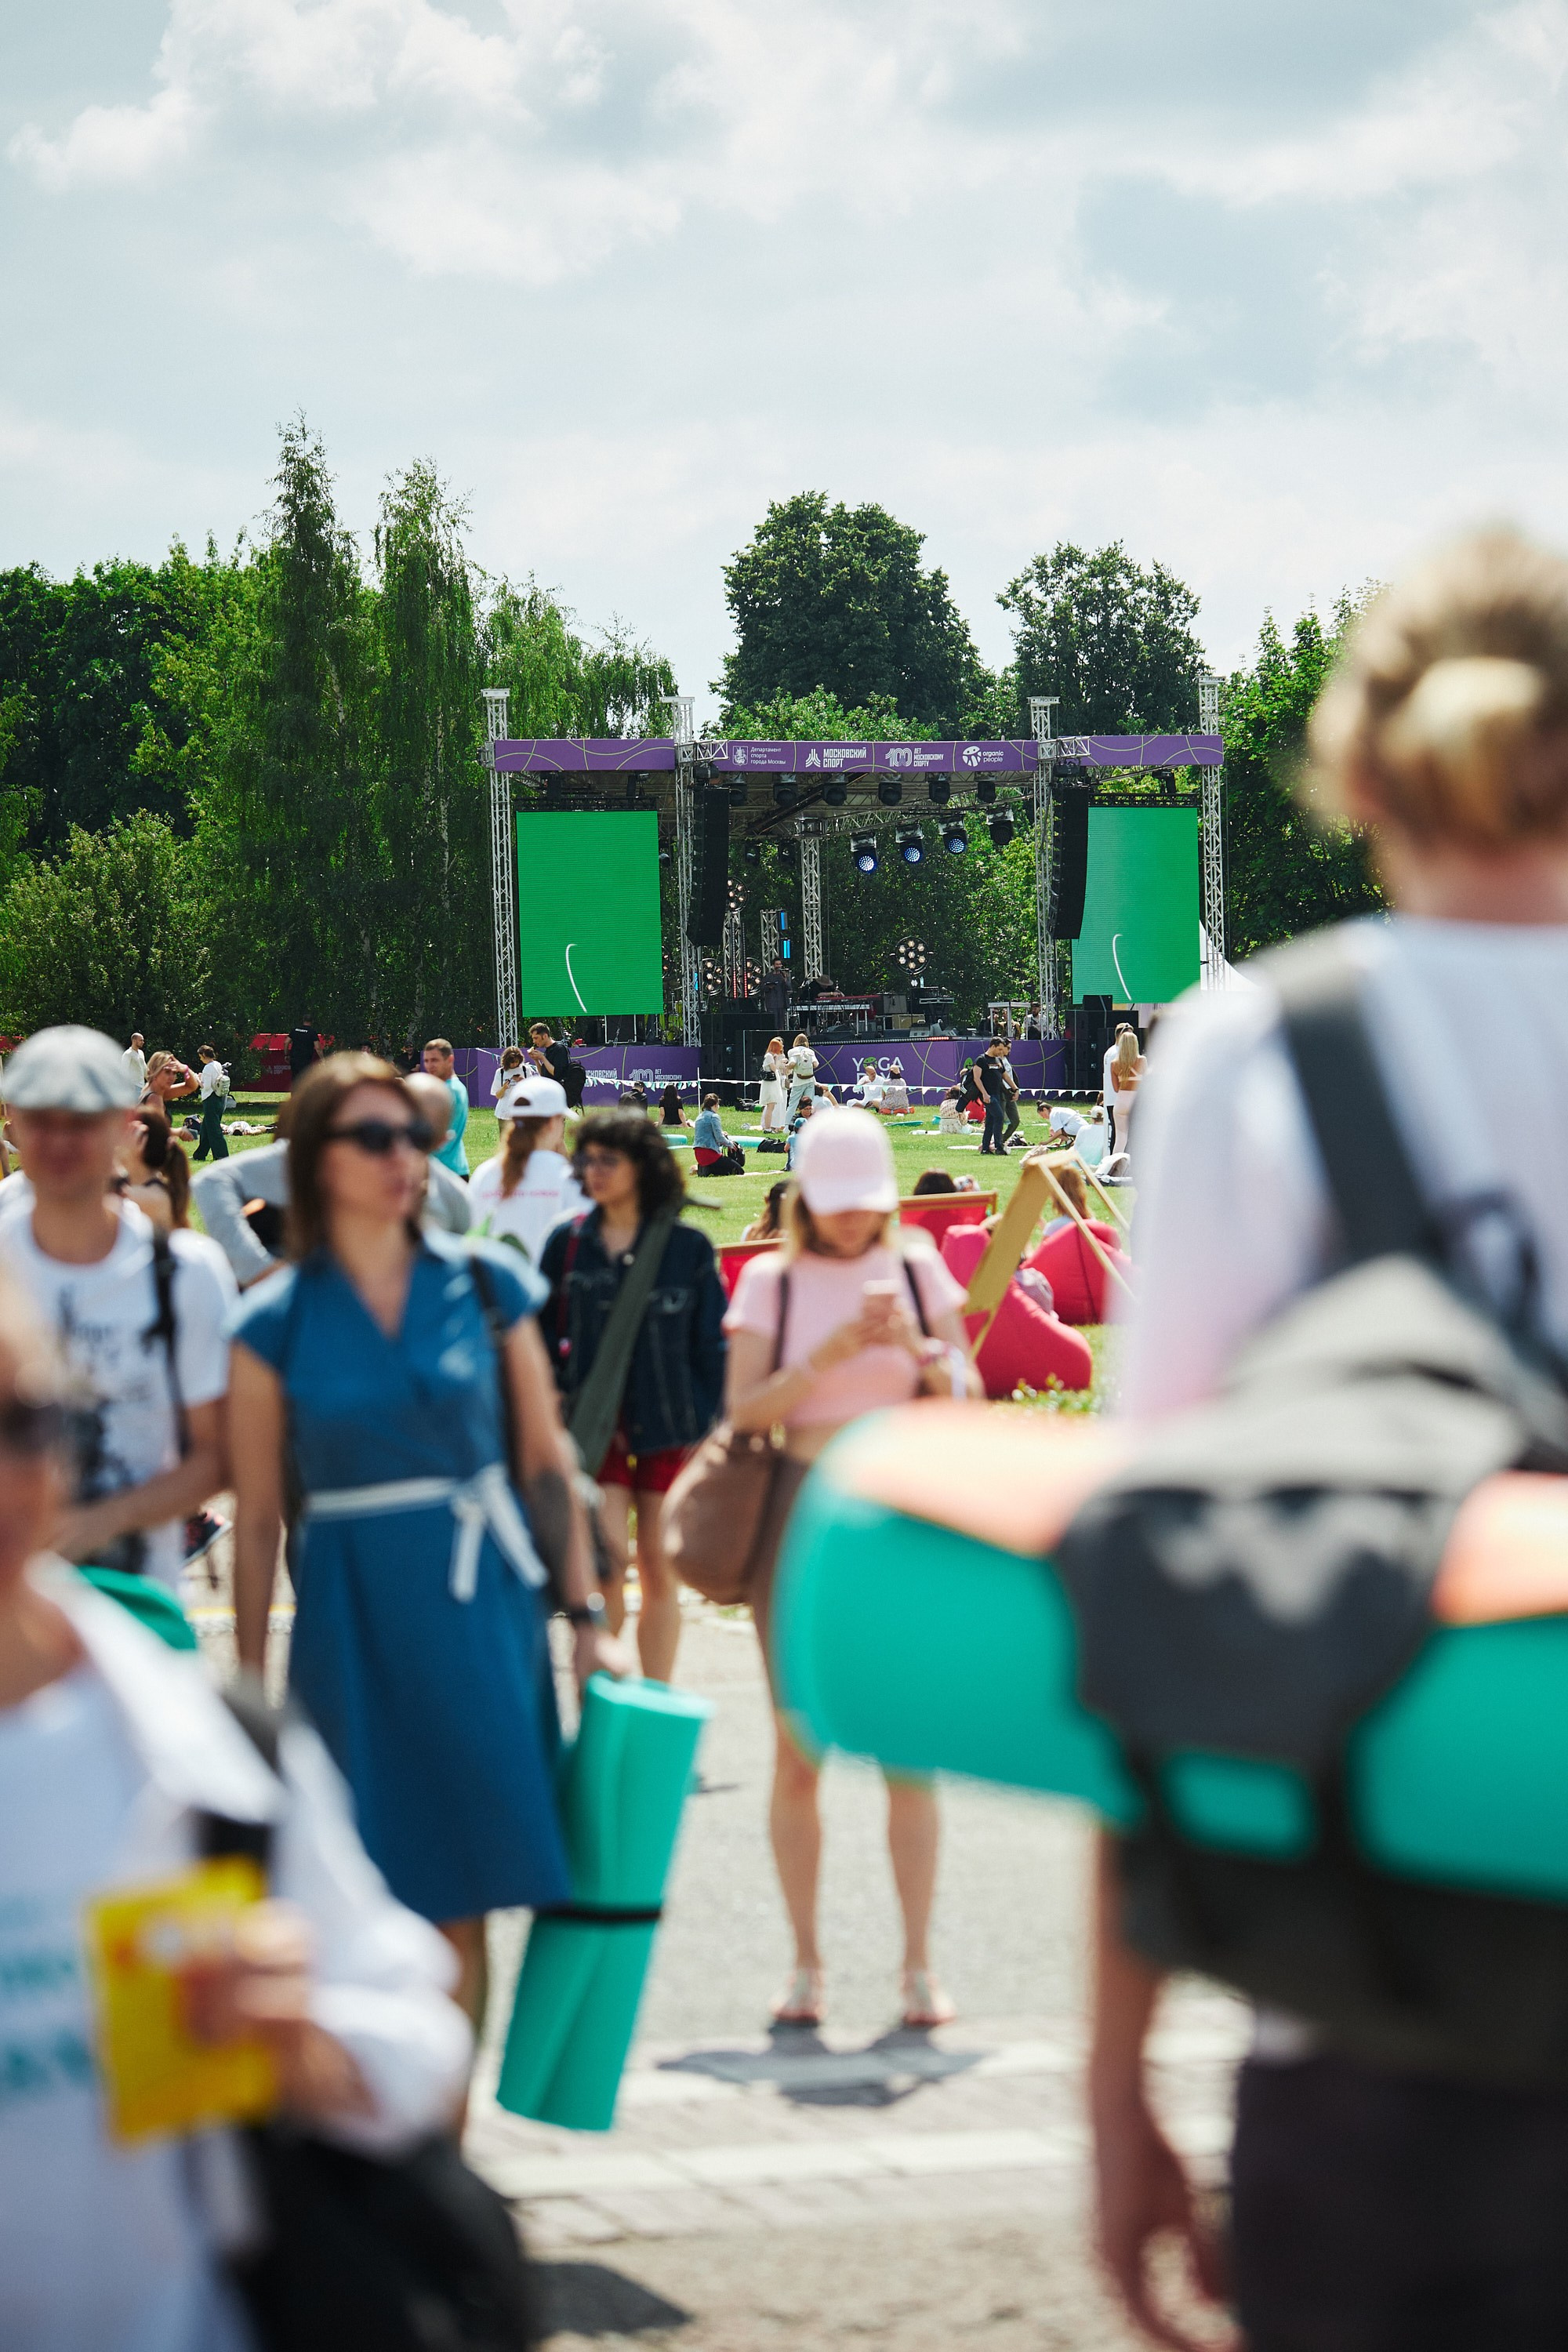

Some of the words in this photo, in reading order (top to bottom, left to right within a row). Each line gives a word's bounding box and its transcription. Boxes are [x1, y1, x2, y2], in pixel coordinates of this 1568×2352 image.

[823, 747, 866, 758] МОСКОВСКИЙ
[885, 748, 913, 767] 100
[823, 759, 844, 768] СПОРТ
